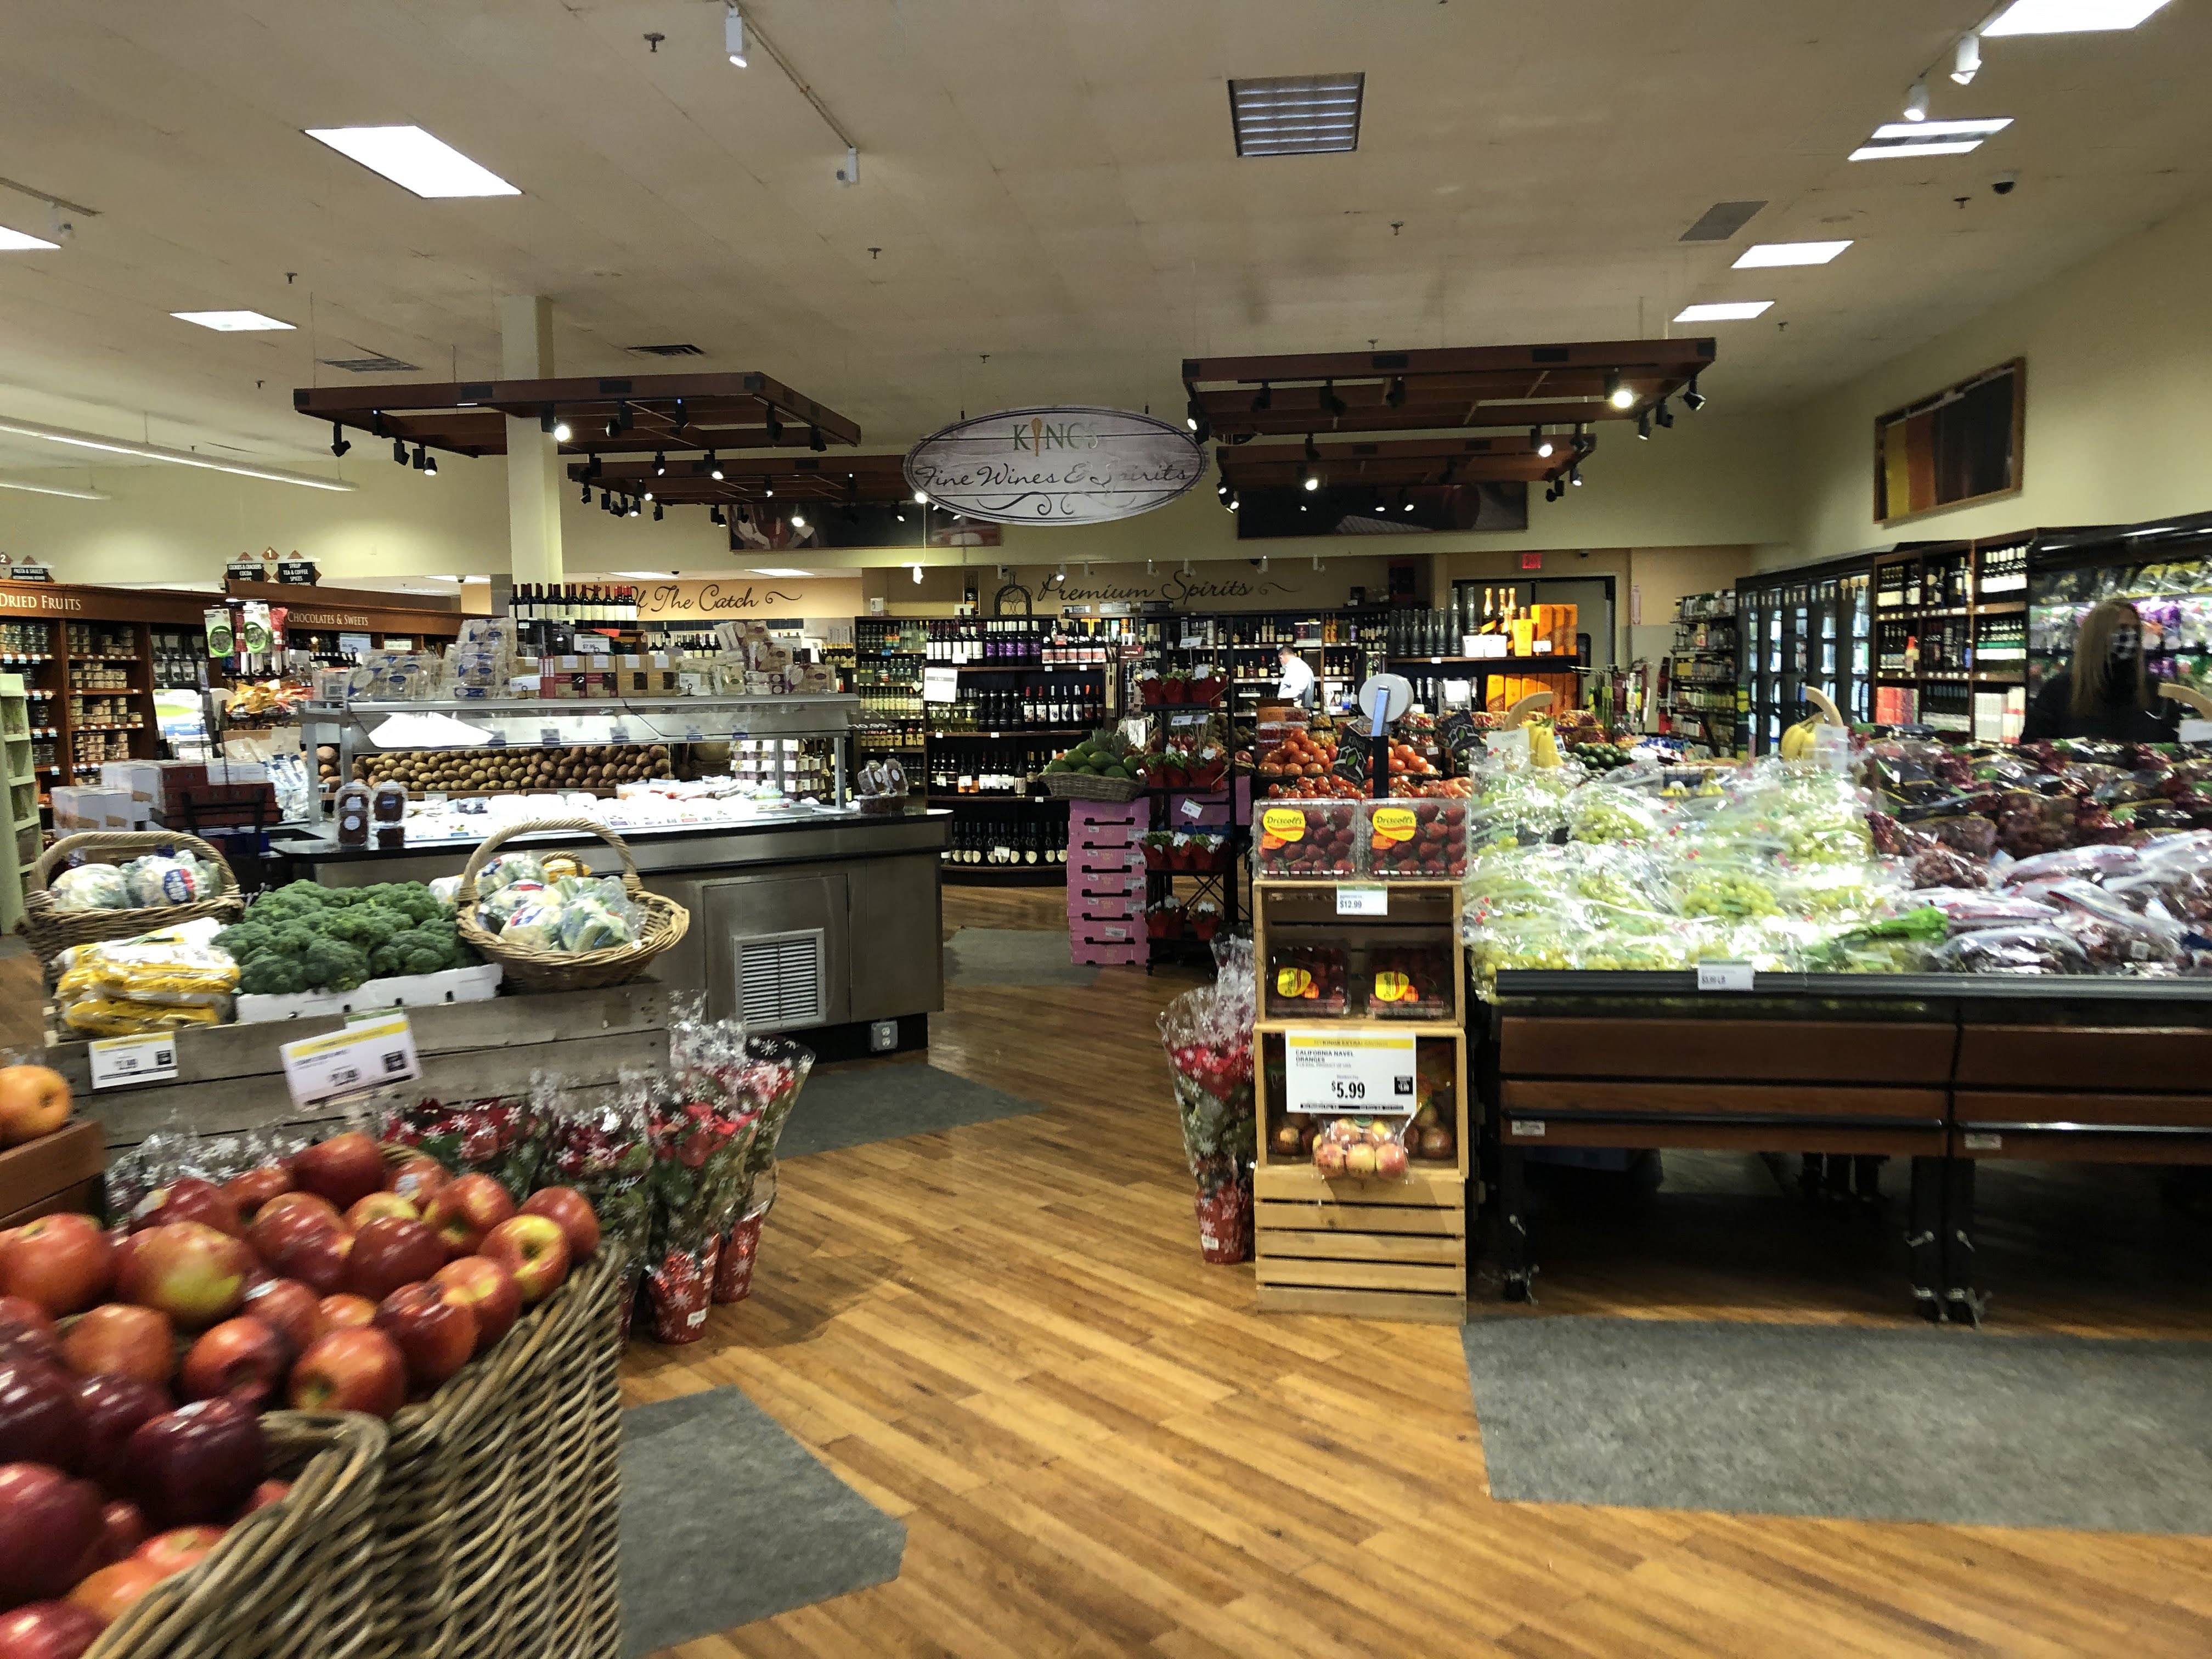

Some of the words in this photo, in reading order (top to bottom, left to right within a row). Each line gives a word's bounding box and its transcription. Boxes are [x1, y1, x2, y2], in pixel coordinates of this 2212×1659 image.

[915, 465, 974, 487] Fine
[977, 462, 1061, 487] Wines
[0, 554, 6, 563] 2
[267, 549, 272, 558] 1
[1037, 574, 1155, 602] Premium
[1161, 570, 1254, 605] Spirits
[0, 592, 37, 608] DRIED
[41, 595, 81, 611] FRUITS
[651, 585, 694, 612] The
[699, 584, 759, 612] Catch
[287, 611, 335, 624] CHOCOLATES
[336, 614, 342, 625] &
[344, 614, 369, 626] SWEETS
[1331, 1080, 1365, 1099] $5.99
